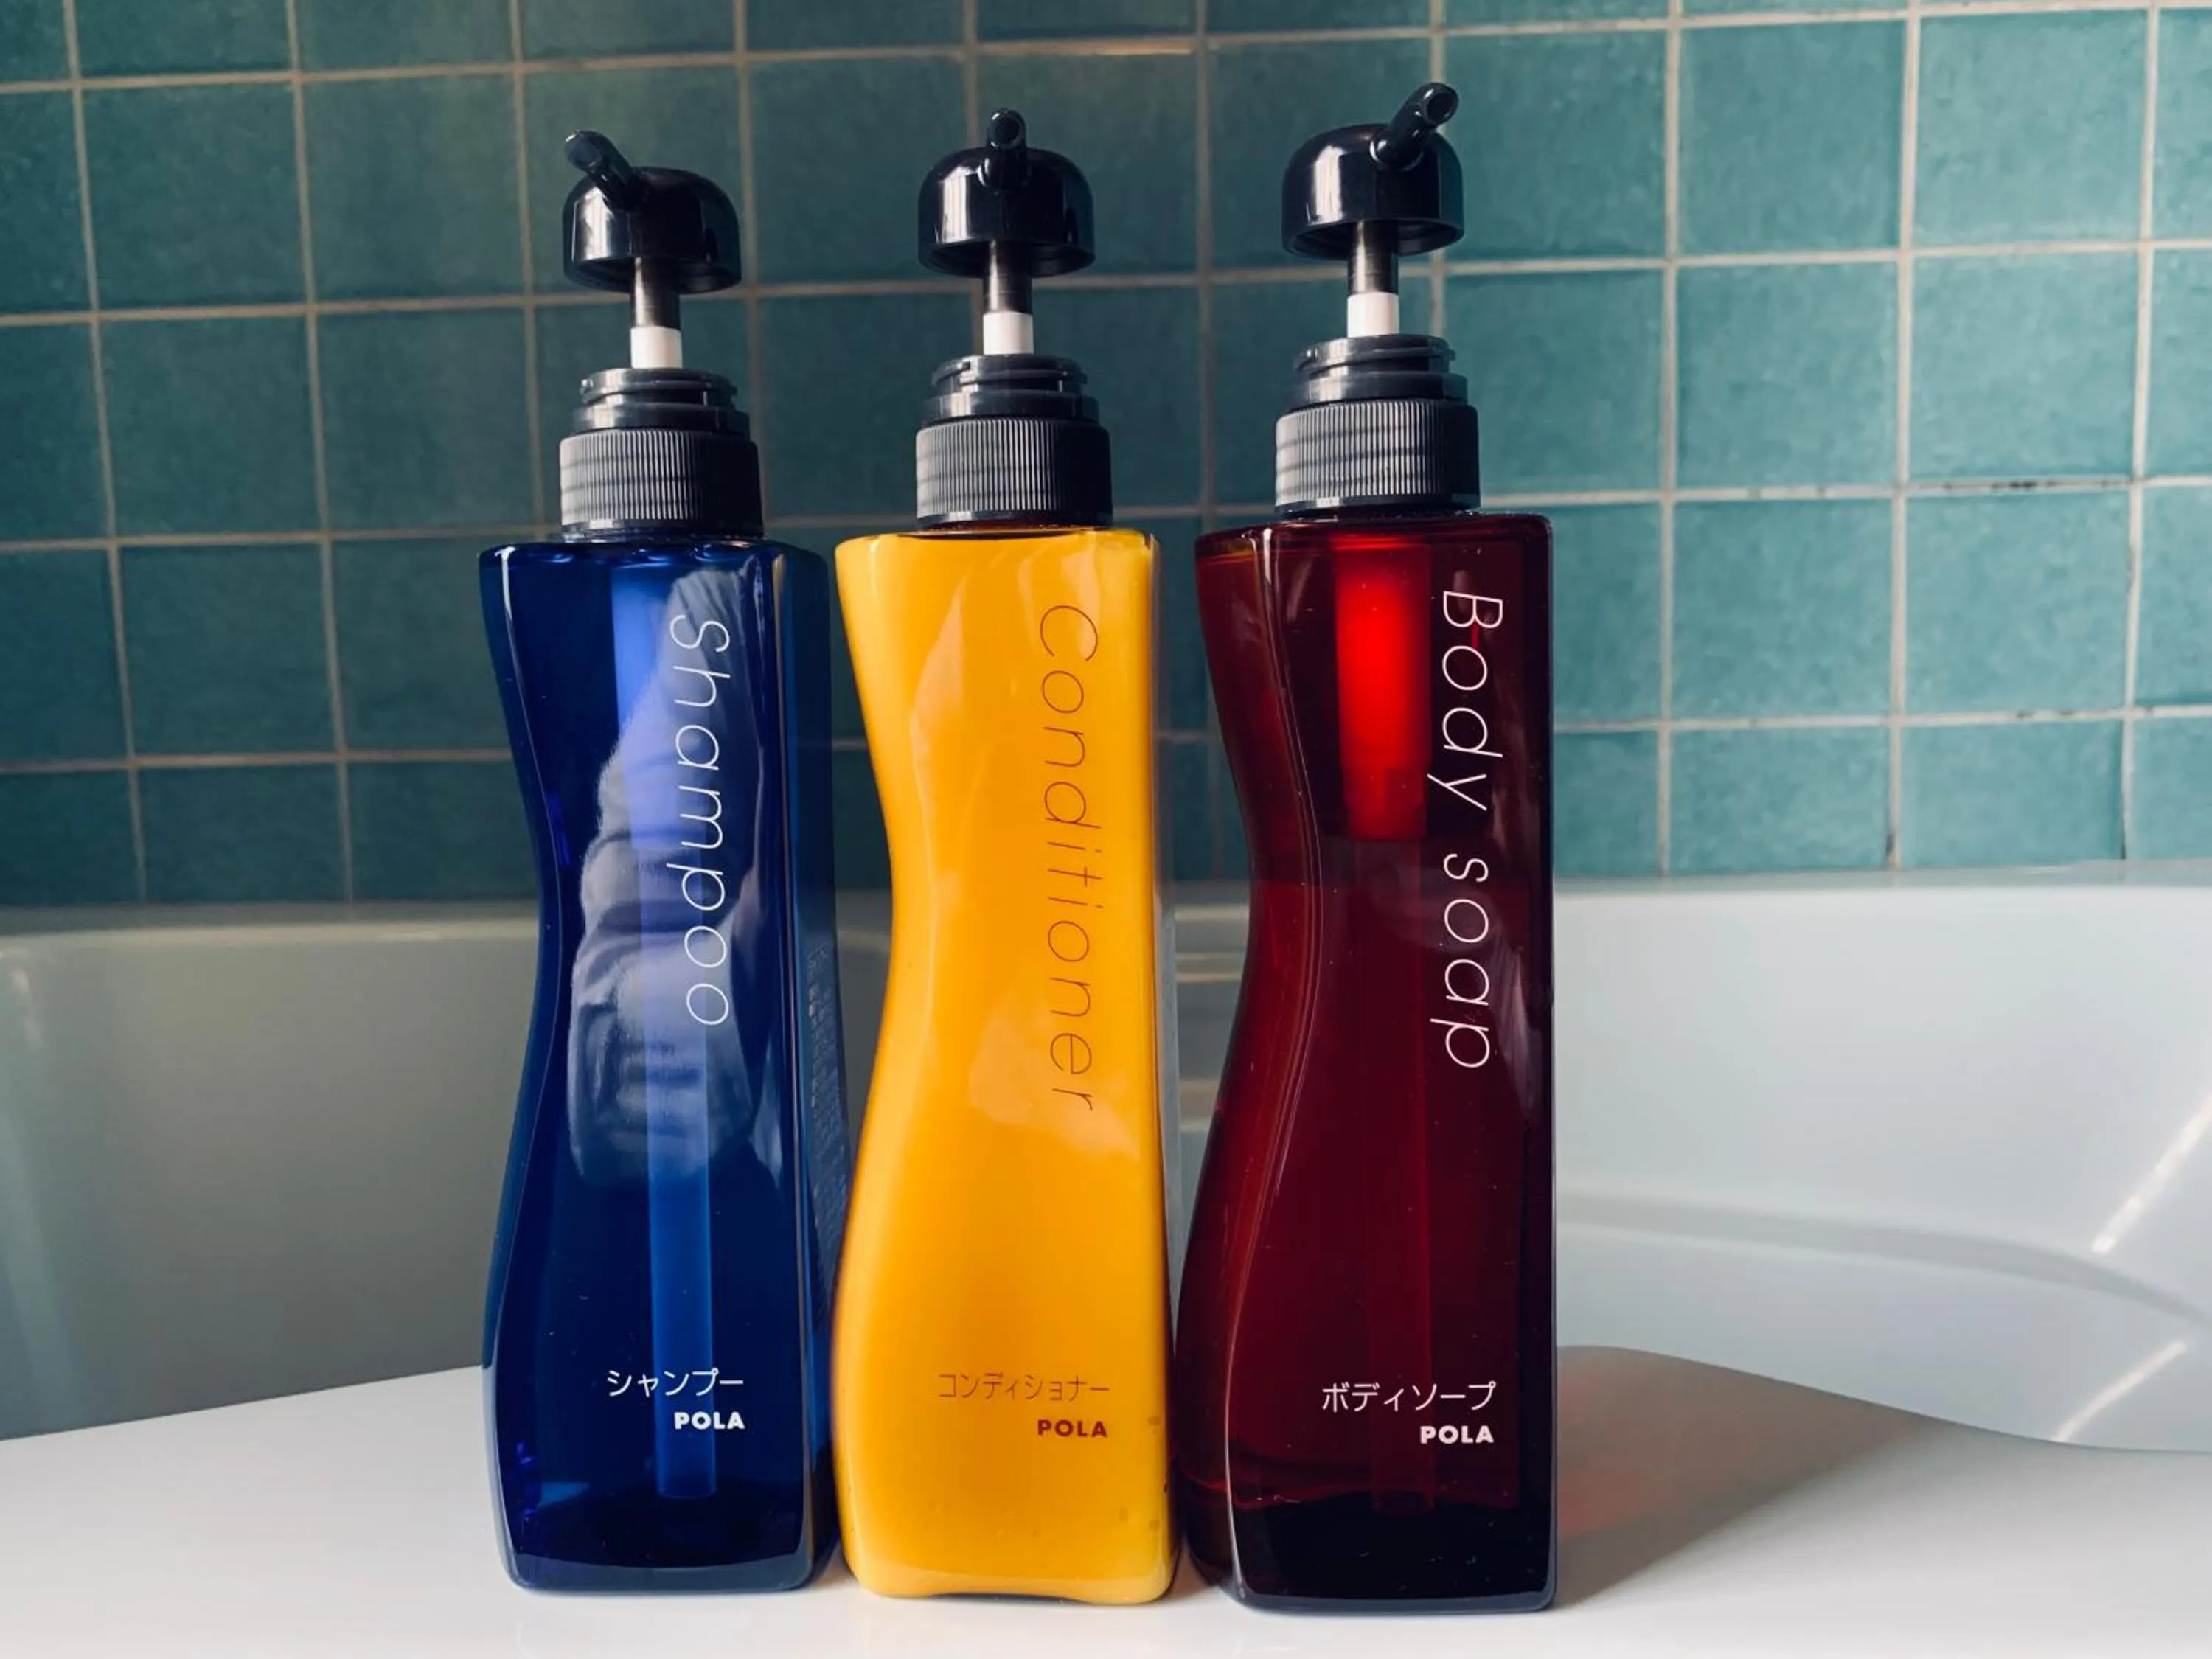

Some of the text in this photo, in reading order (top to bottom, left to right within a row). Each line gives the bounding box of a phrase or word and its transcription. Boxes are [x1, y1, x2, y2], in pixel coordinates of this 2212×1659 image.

[666, 613, 731, 1026] Shampoo
[1427, 590, 1504, 1069] Body soap
[1040, 605, 1104, 1111] Conditioner
[607, 1368, 744, 1398] シャンプー
[938, 1372, 1110, 1402] コンディショナー
[1321, 1380, 1497, 1413] ボディソープ
[674, 1411, 745, 1430] POLA
[1037, 1419, 1108, 1438] POLA
[1420, 1425, 1495, 1444] POLA
